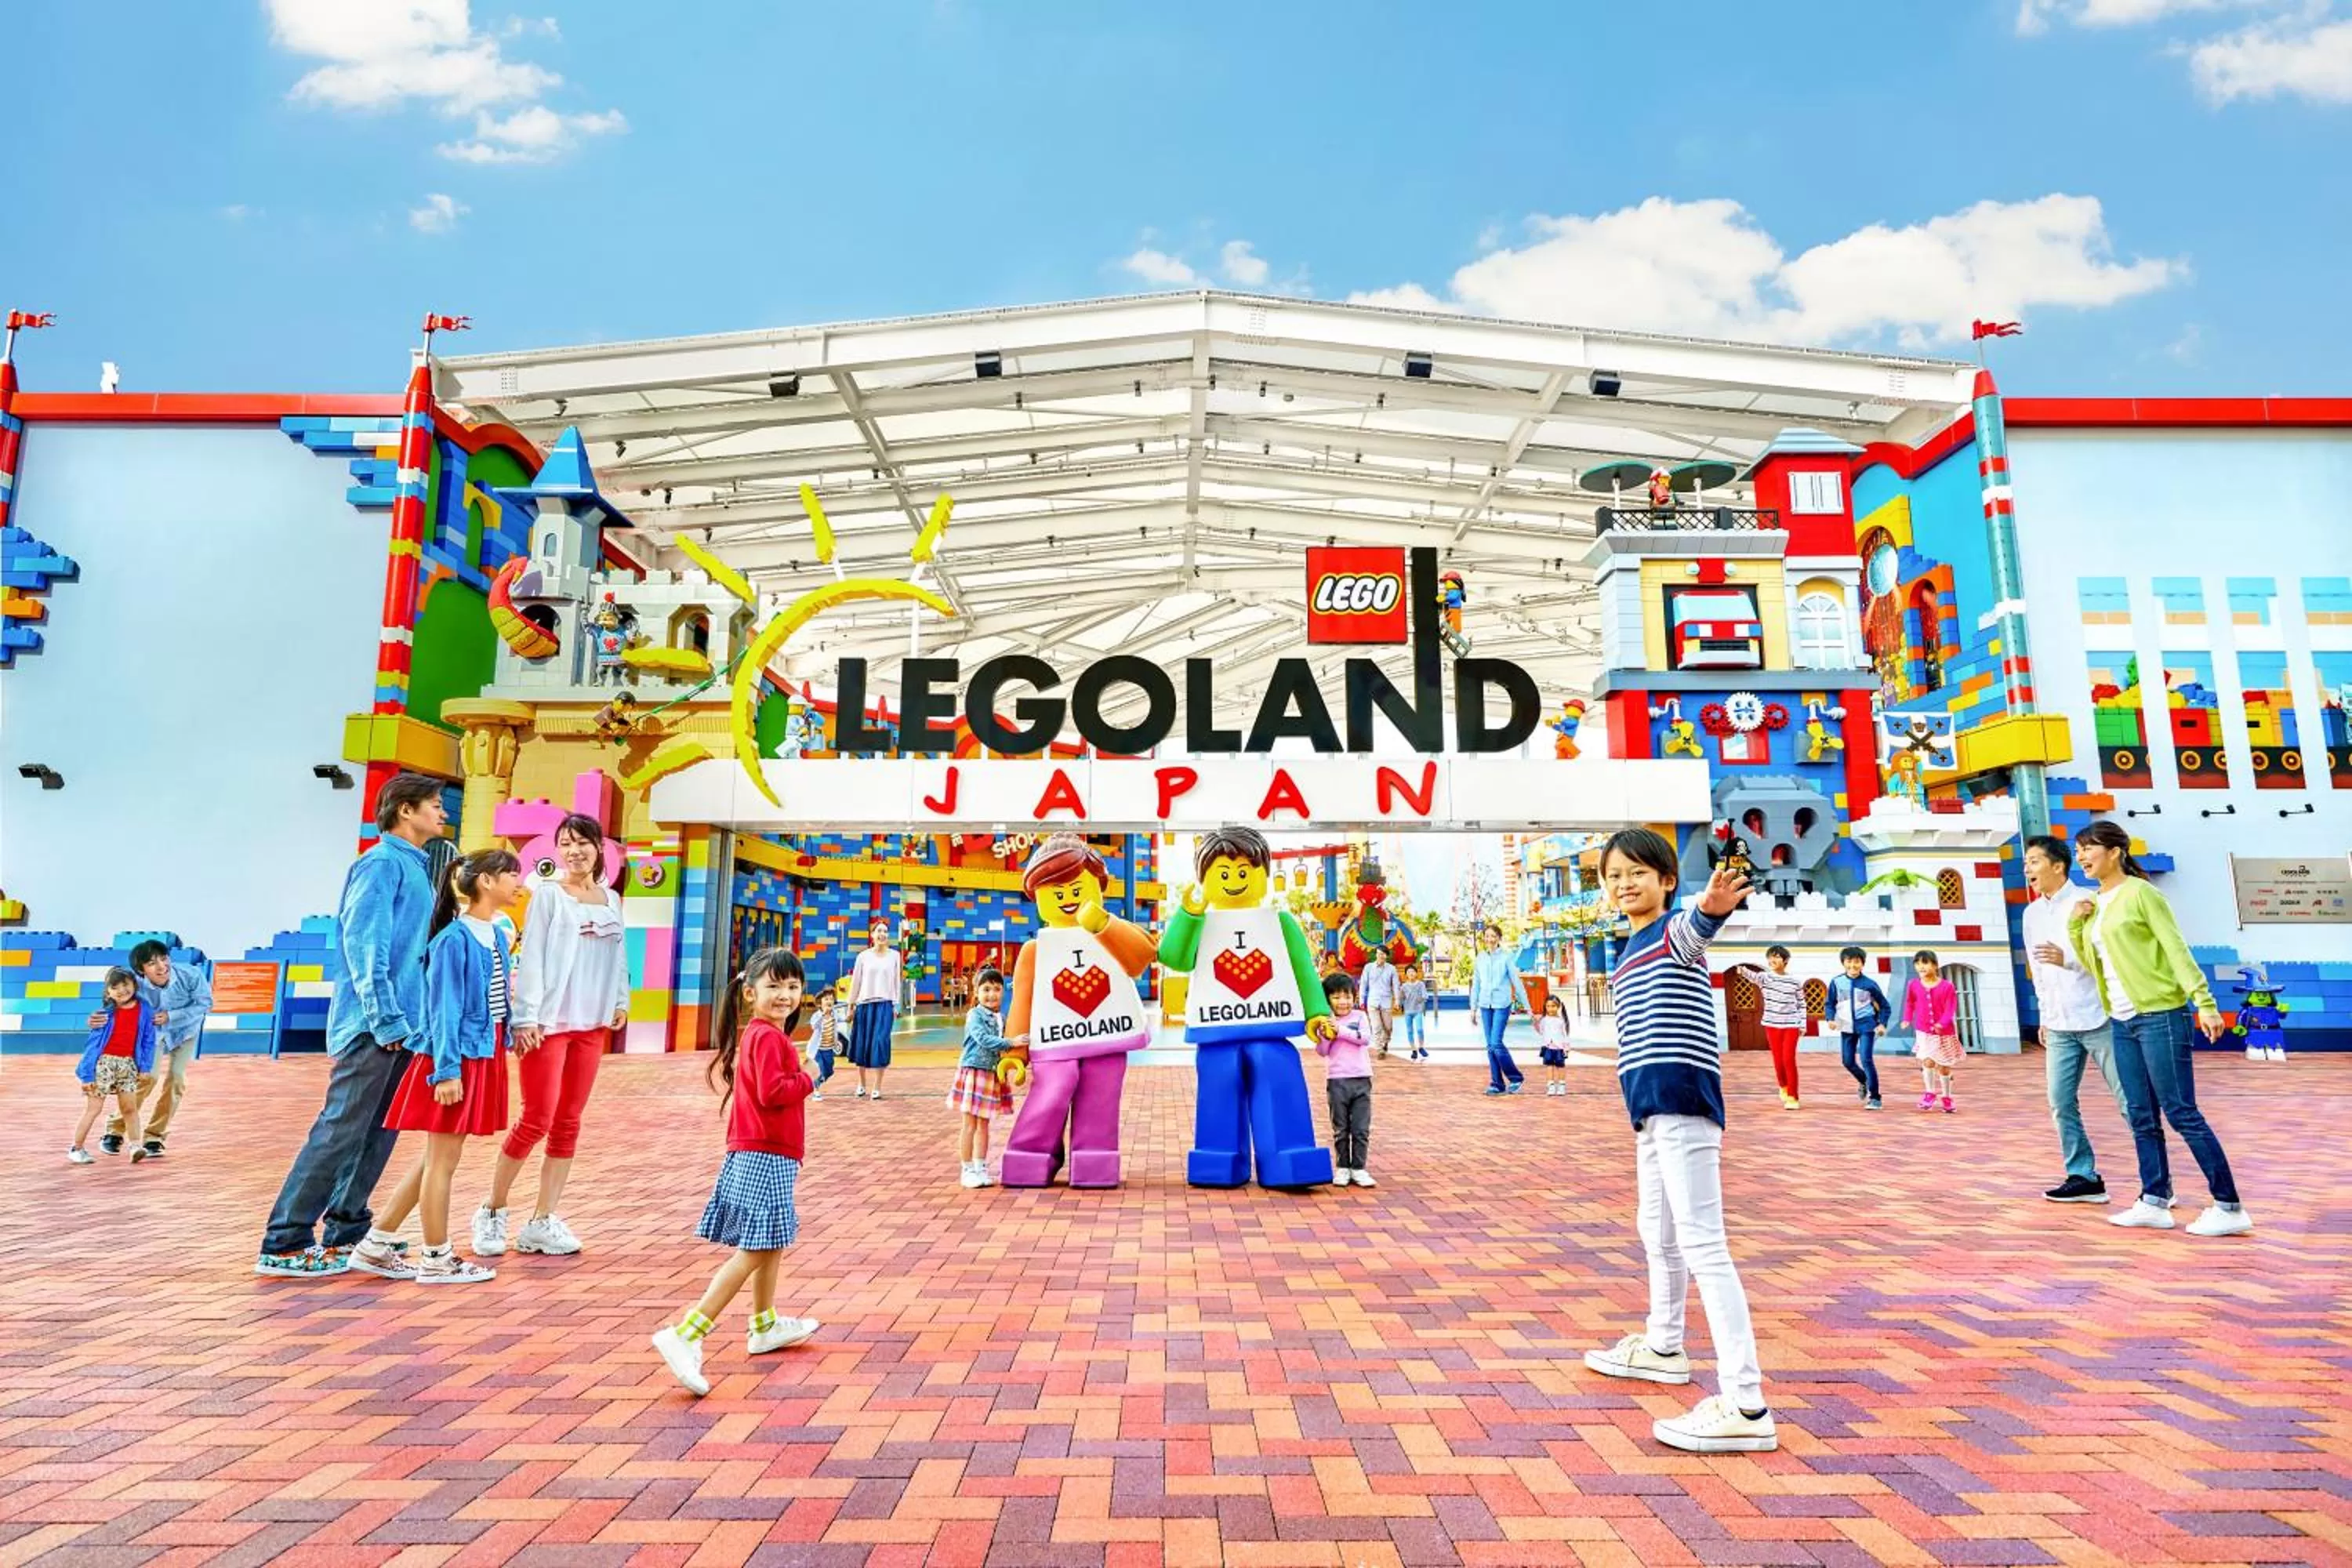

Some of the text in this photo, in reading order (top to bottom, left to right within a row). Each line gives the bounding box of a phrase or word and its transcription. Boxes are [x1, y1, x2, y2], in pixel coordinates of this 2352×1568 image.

[1315, 575, 1400, 612] LEGO
[834, 546, 1542, 754] LEGOLAND
[924, 760, 1438, 819] JAPAN
[991, 832, 1037, 859] SHOP
[1233, 931, 1247, 949] I
[1072, 949, 1085, 968] I
[1199, 1000, 1292, 1023] LEGOLAND
[1040, 1015, 1134, 1044] LEGOLAND
